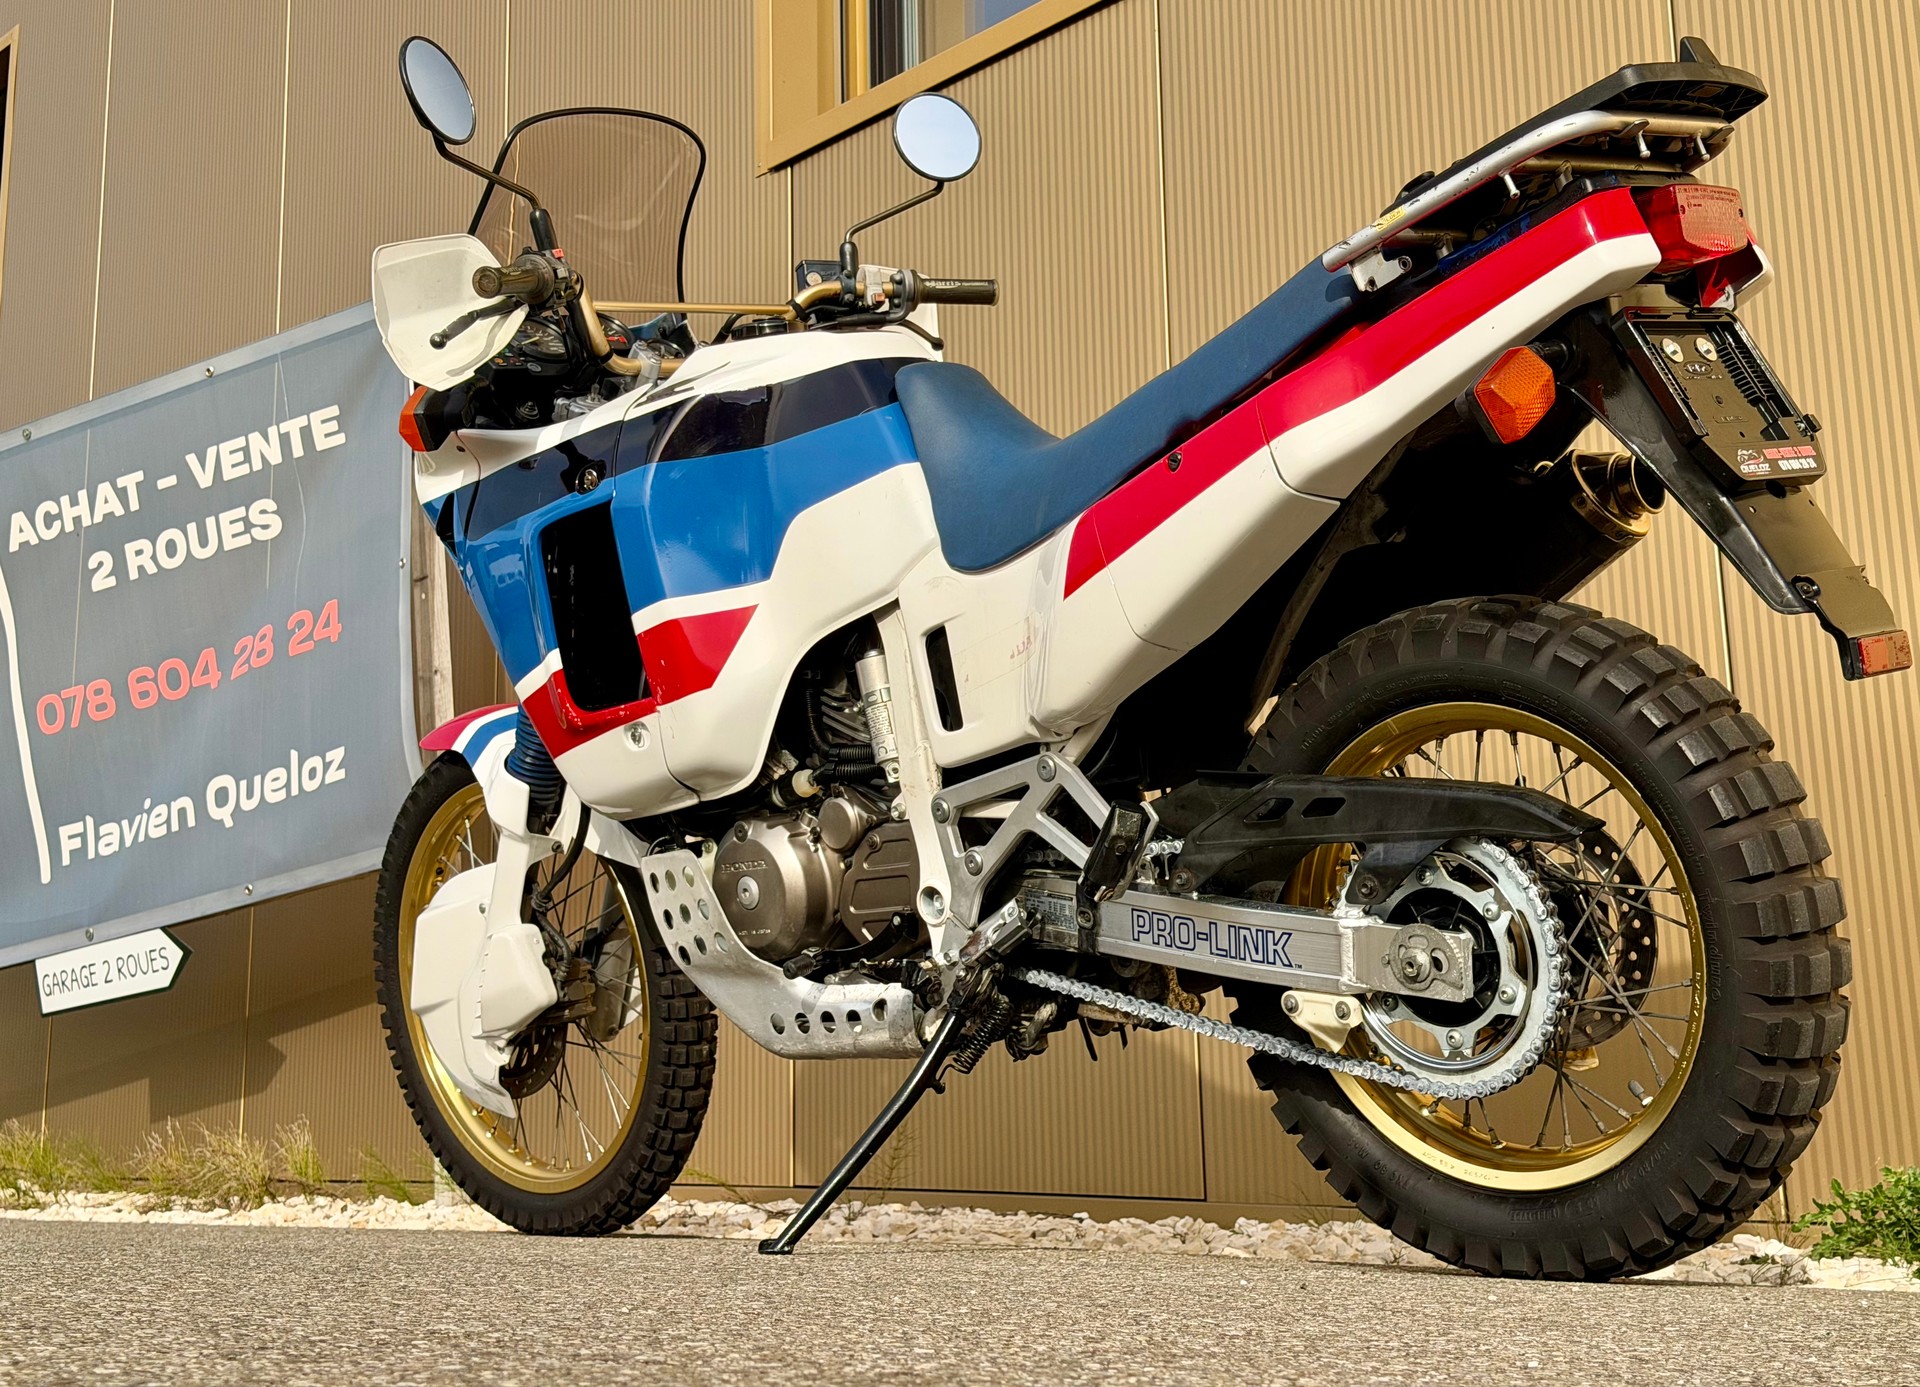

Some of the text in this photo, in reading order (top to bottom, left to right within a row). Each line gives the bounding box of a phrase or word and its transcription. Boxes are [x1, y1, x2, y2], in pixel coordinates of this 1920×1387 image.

[8, 470, 144, 552] ACHAT
[185, 404, 346, 489] VENTE
[87, 498, 283, 592] 2 ROUES
[36, 598, 342, 735] 078 604 28 24
[58, 746, 346, 867] Flavien Queloz
[721, 861, 768, 873] HONDA
[42, 947, 170, 997] GARAGE 2 ROUES
[1131, 908, 1293, 968] PRO-LINK
